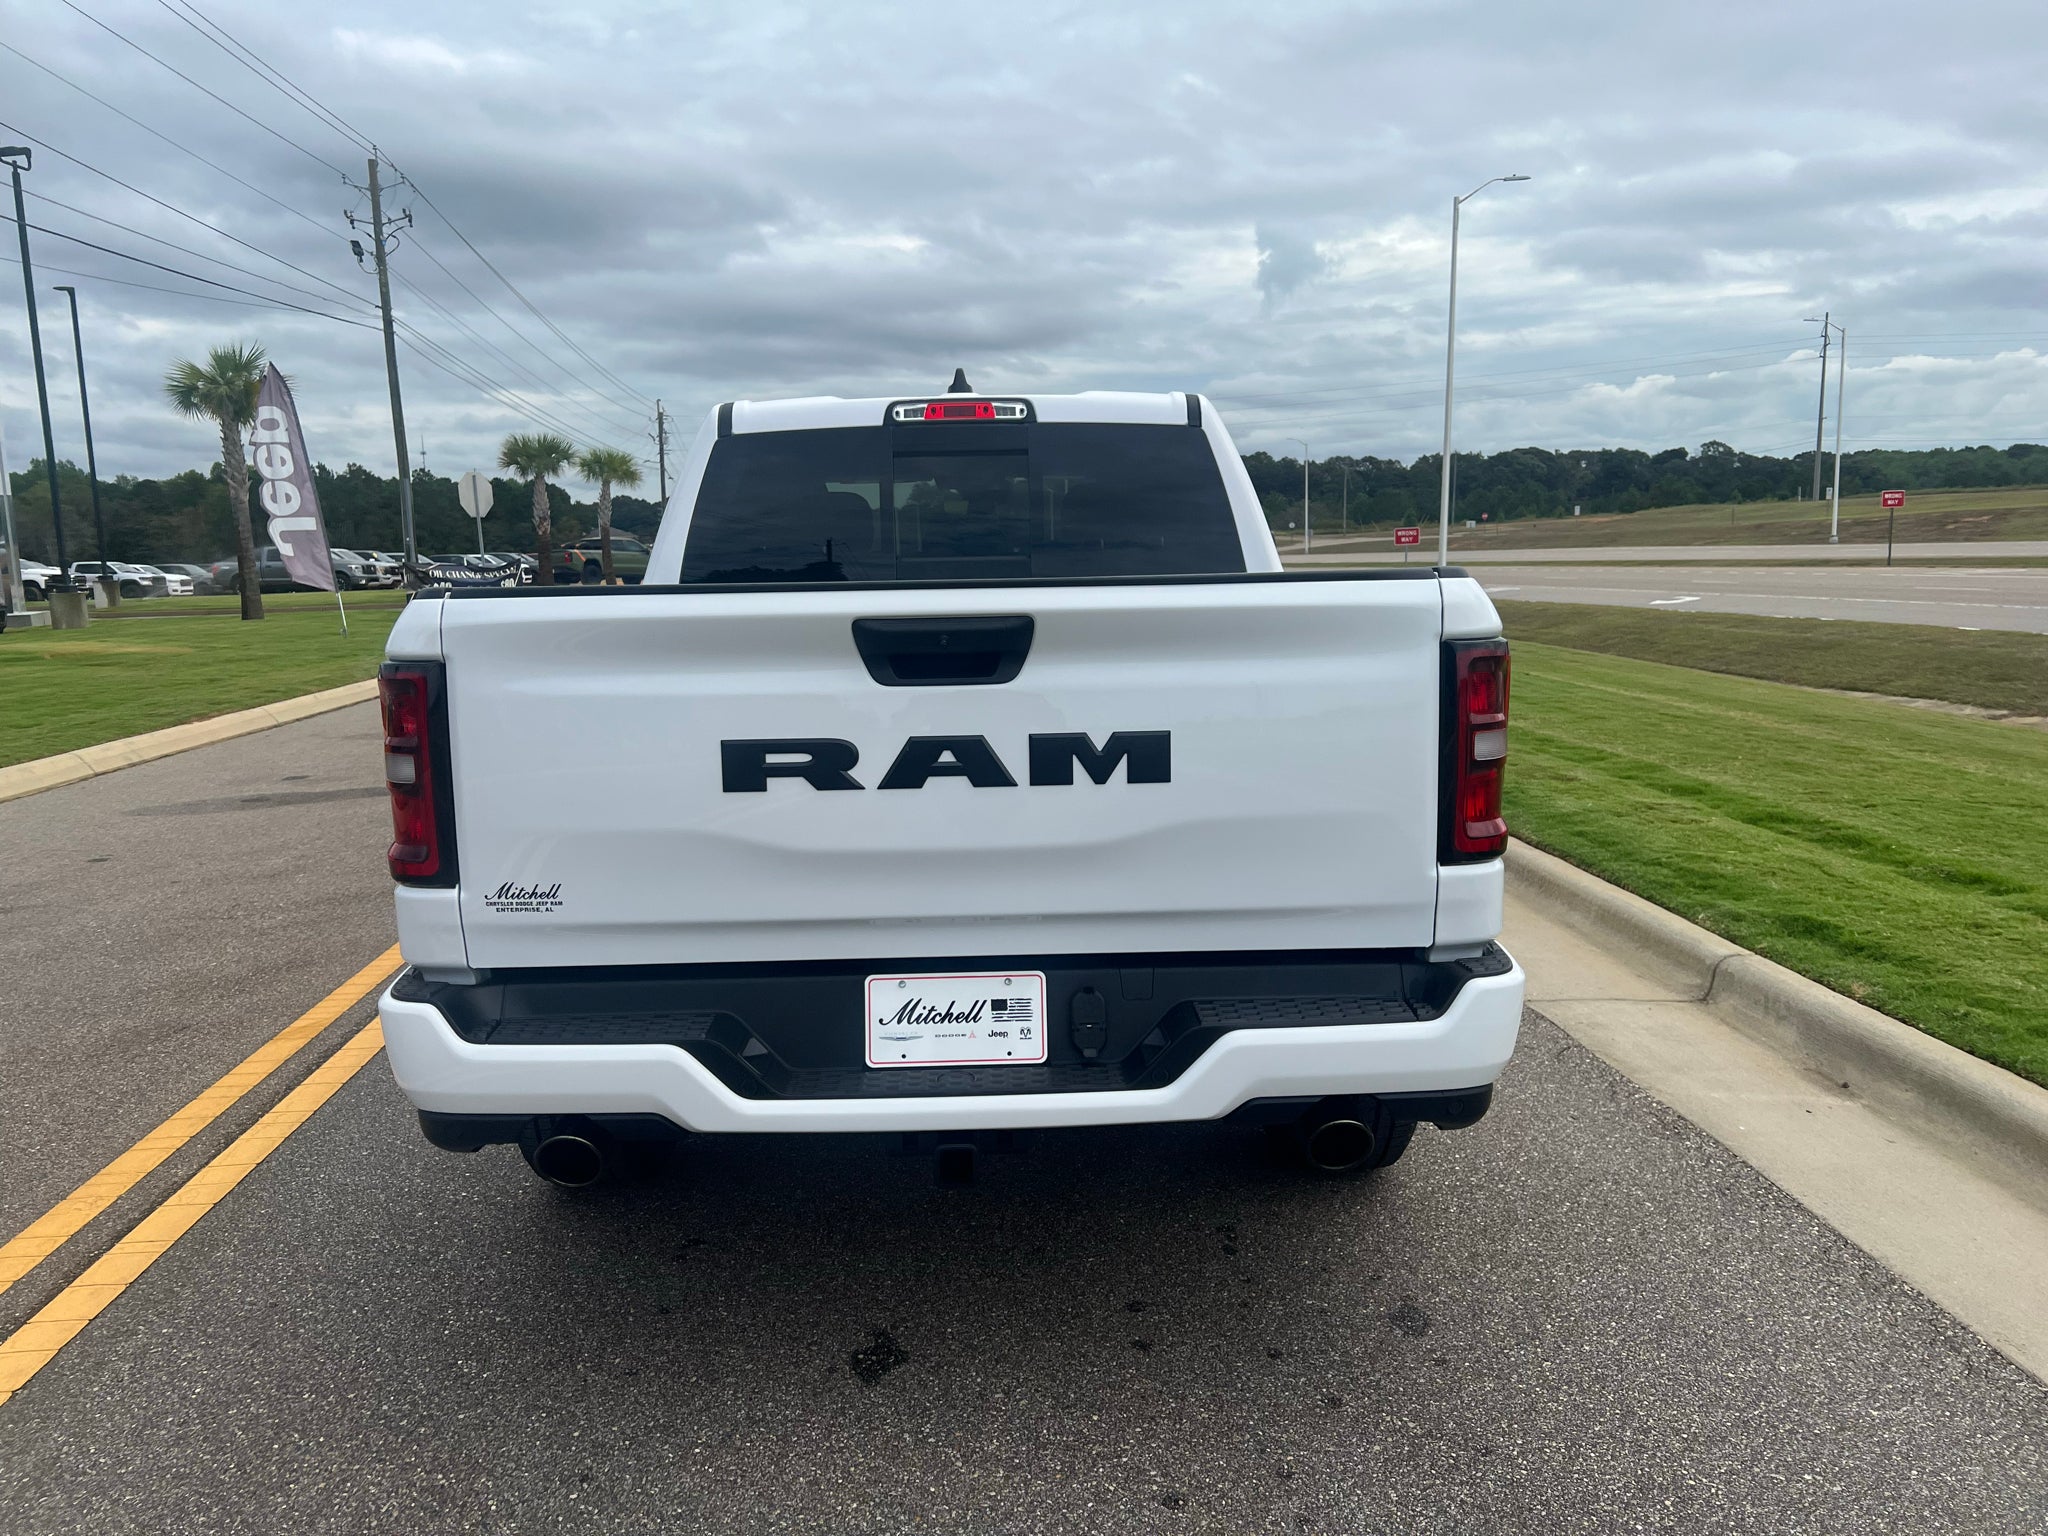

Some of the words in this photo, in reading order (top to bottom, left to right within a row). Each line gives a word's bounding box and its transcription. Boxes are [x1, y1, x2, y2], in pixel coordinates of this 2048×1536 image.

[429, 569, 445, 579] OIL
[446, 570, 482, 579] CHANGE
[720, 730, 1172, 793] RAM
[484, 881, 562, 901] Mitchell
[879, 998, 988, 1026] Mitchell
[988, 1029, 1009, 1039] Jeep
